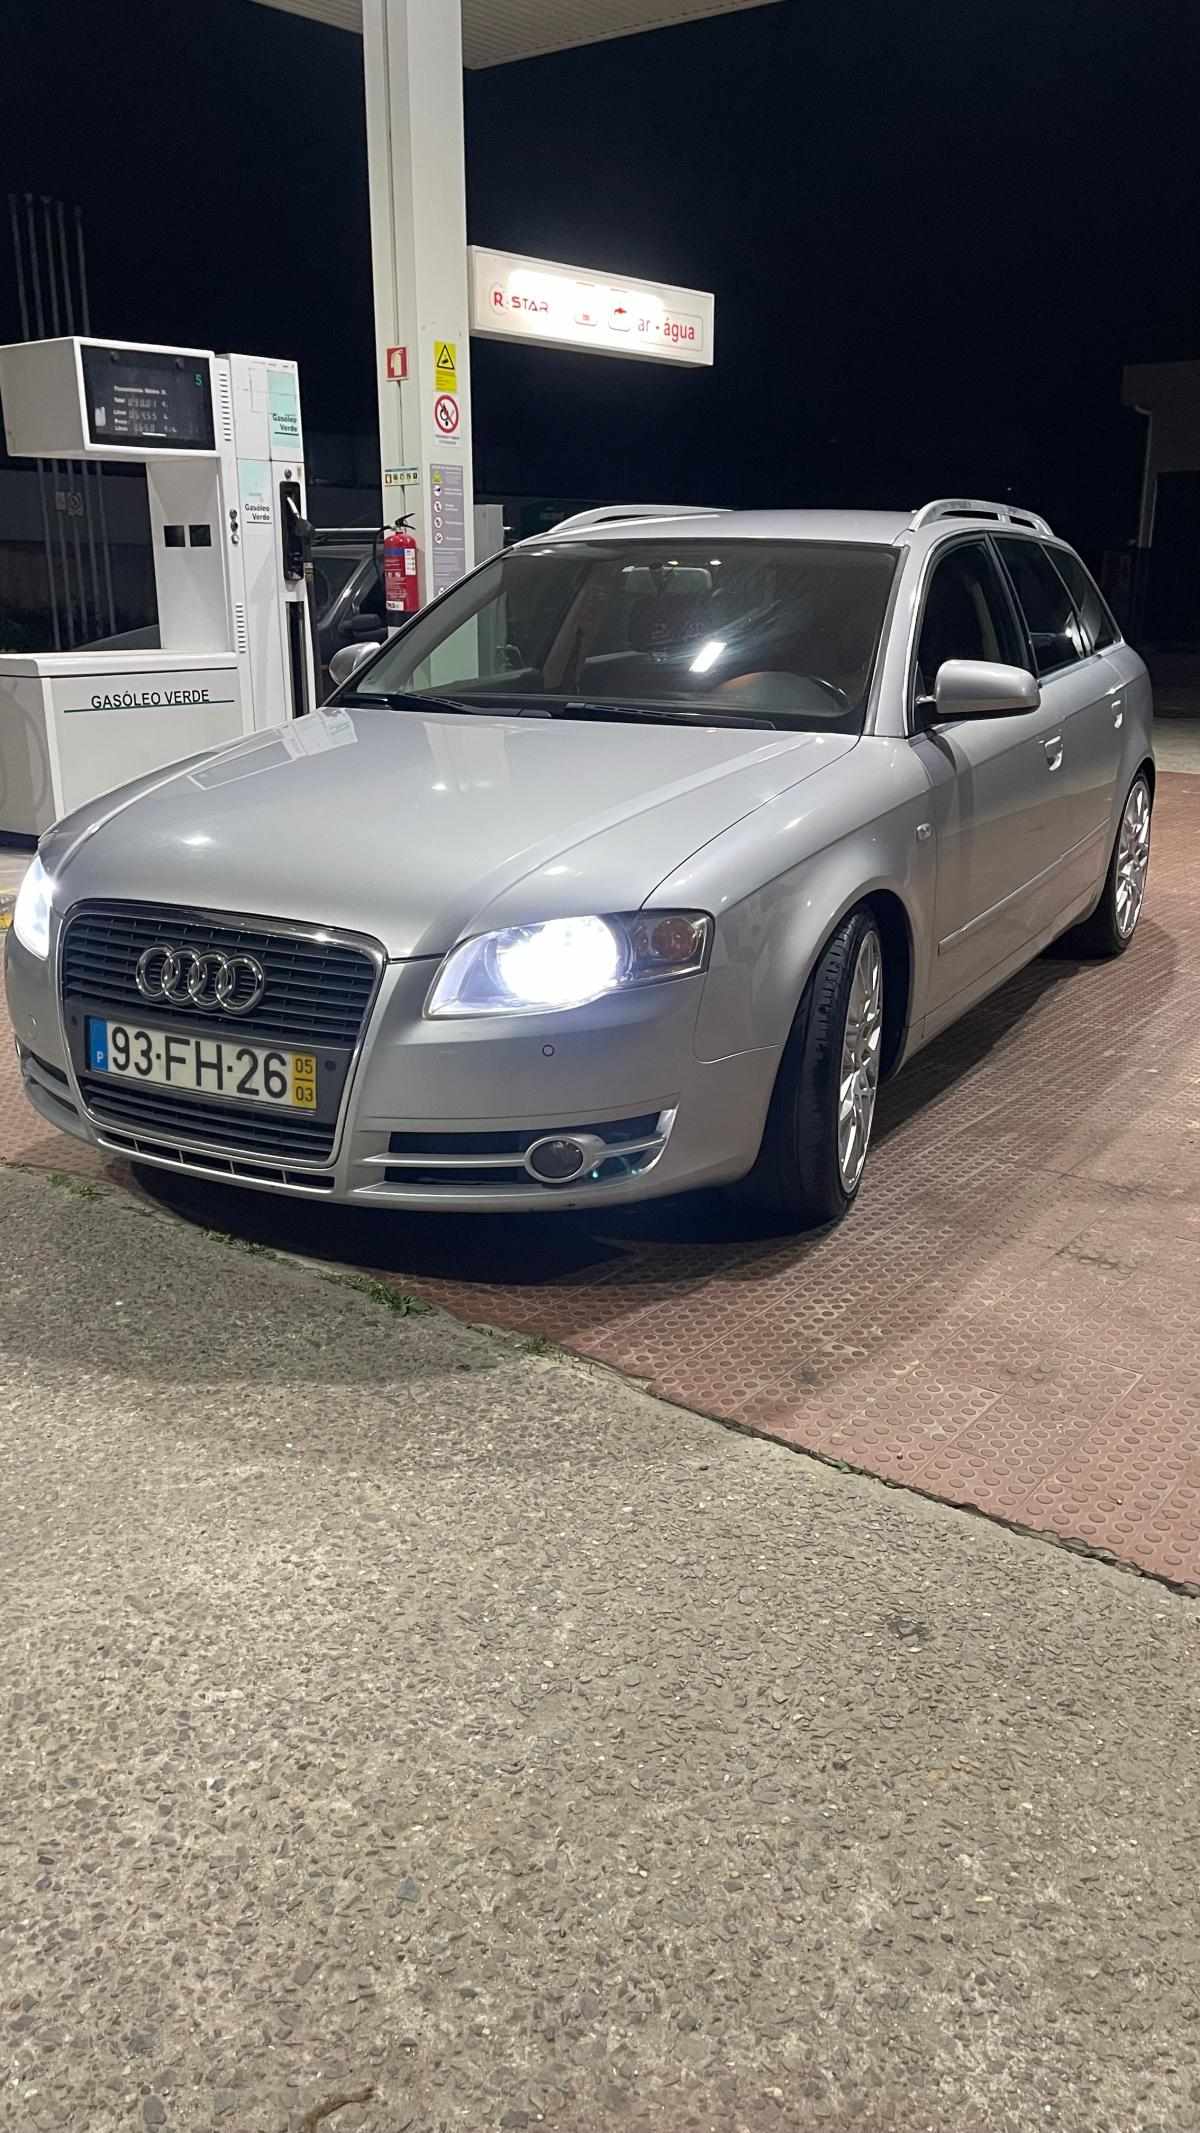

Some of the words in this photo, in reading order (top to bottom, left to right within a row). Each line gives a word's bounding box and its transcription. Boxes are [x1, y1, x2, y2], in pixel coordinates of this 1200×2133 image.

[637, 316, 651, 332] ar
[663, 317, 696, 342] água
[91, 690, 161, 710] GASÓLEO
[164, 689, 210, 704] VERDE
[96, 1051, 105, 1063] P
[295, 1057, 314, 1075] 05
[295, 1085, 314, 1102] 03
